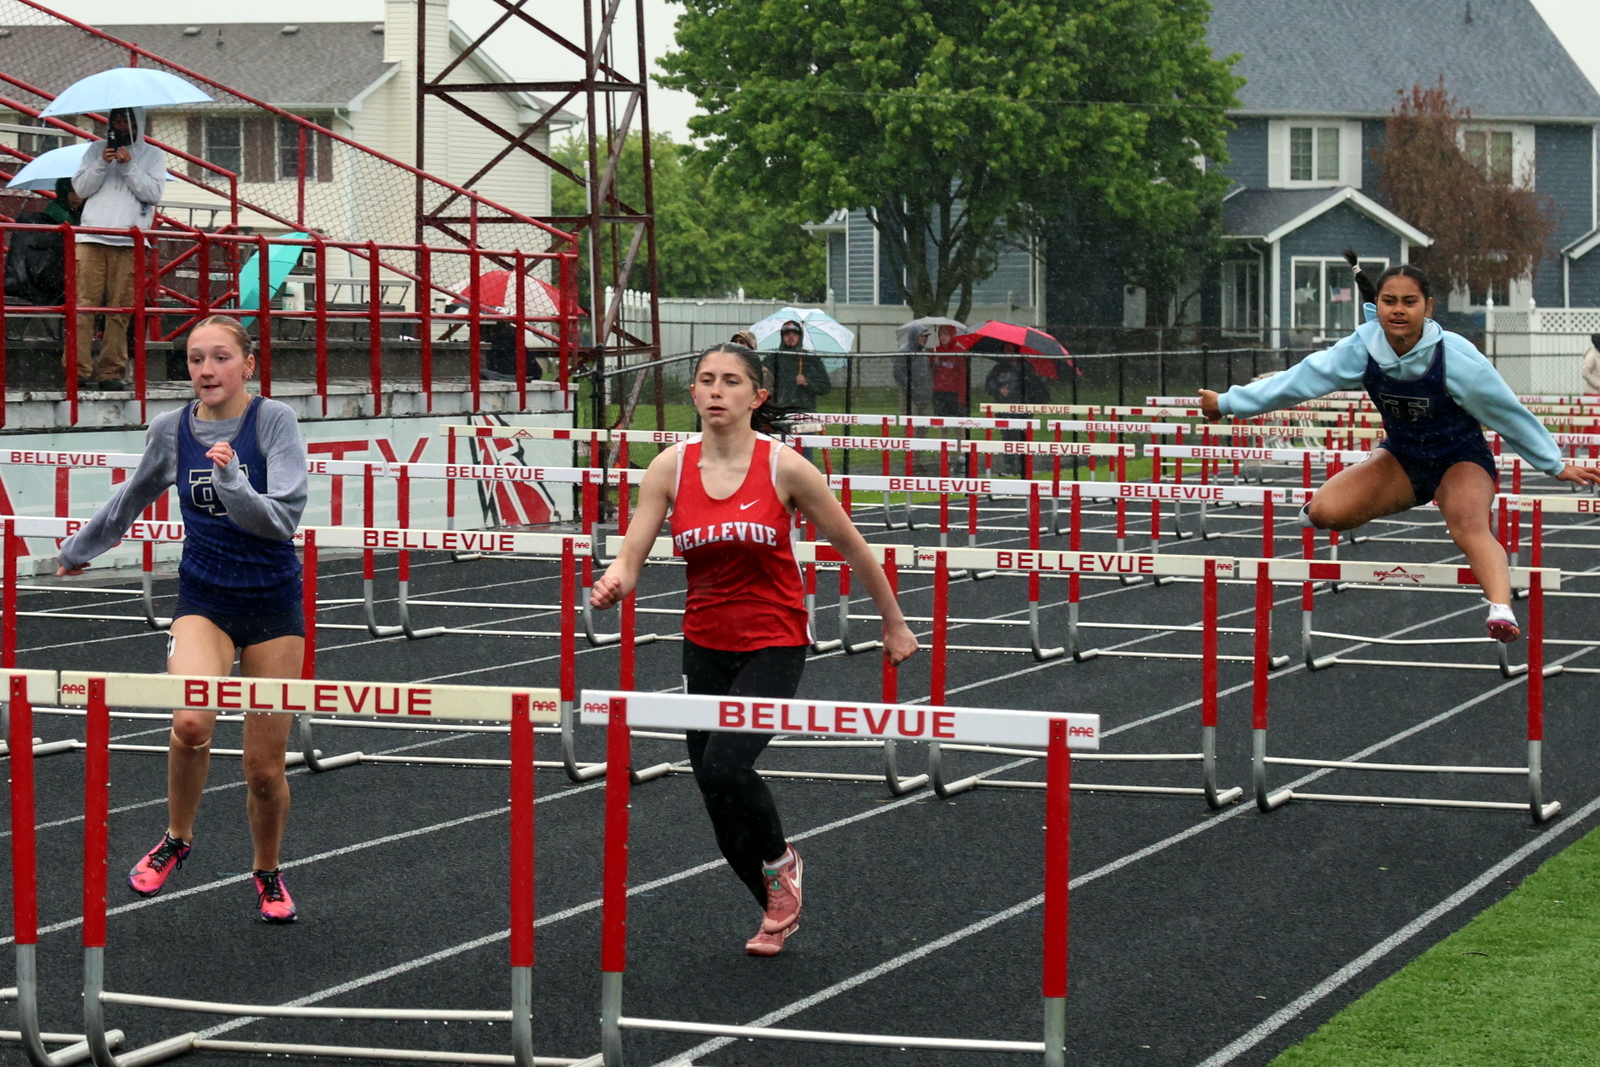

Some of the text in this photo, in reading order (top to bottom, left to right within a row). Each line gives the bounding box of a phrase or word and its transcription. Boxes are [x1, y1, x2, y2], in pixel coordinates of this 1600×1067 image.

[1010, 405, 1070, 414] BELLEVUE
[793, 414, 858, 424] BELLEVUE
[1085, 423, 1152, 432] BELLEVUE
[1231, 426, 1304, 437] BELLEVUE
[831, 438, 910, 449] BELLEVUE
[1004, 442, 1091, 455] BELLEVUE
[10, 451, 107, 466] BELLEVUE
[1191, 448, 1273, 460] BELLEVUE
[446, 466, 545, 480] BELLEVUE
[889, 478, 991, 493] BELLEVUE
[1120, 485, 1224, 500] BELLEVUE
[363, 530, 514, 551] BELLEVUE
[674, 521, 777, 552] BELLEVUE
[997, 551, 1154, 573] BELLEVUE
[184, 679, 432, 716] BELLEVUE
[718, 701, 956, 738] BELLEVUE
